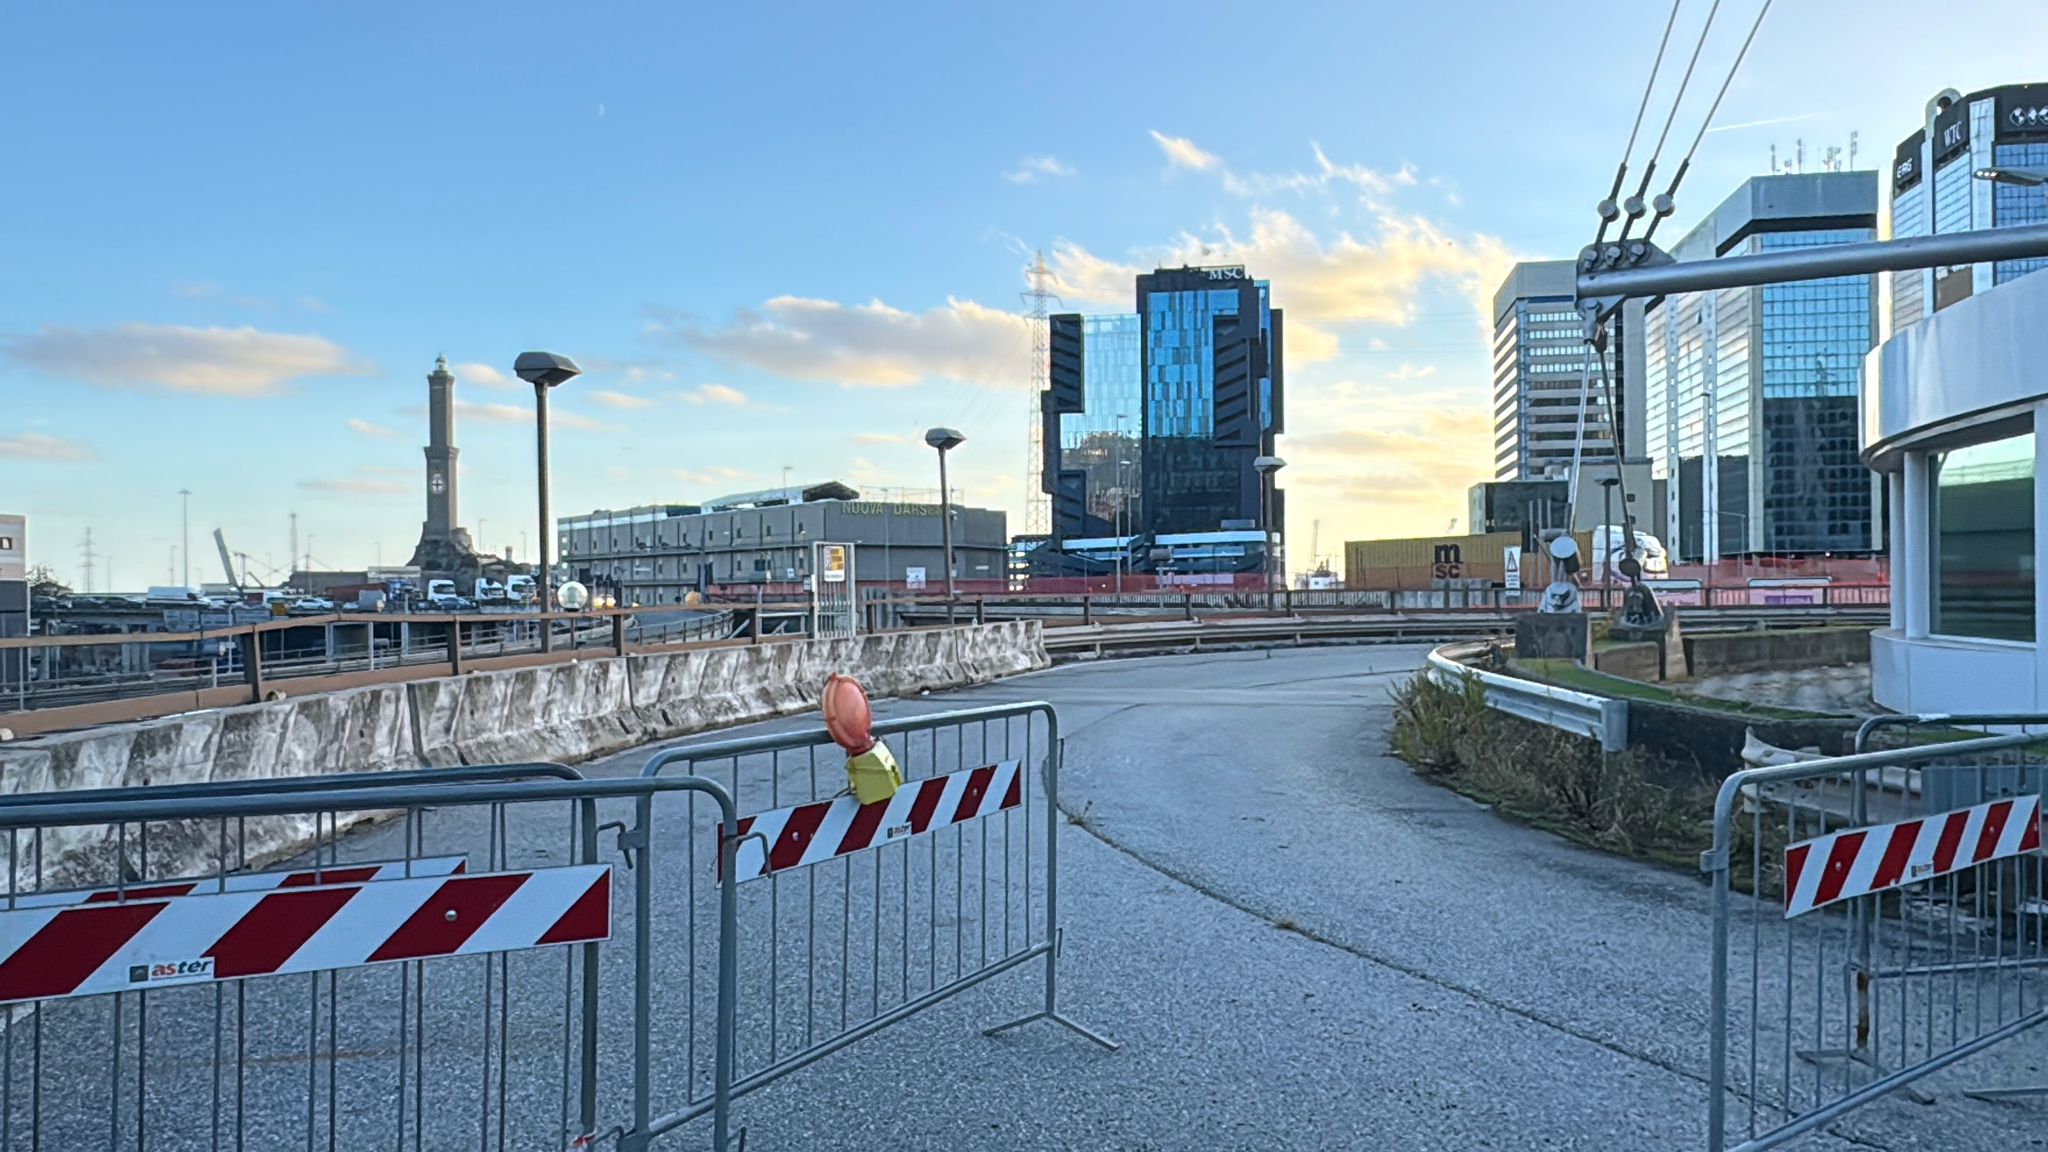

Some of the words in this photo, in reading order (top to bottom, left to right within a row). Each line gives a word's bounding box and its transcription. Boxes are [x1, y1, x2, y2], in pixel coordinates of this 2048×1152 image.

[1944, 121, 1962, 147] WTC
[1209, 267, 1244, 280] MSC
[841, 501, 884, 515] NUOVA
[152, 961, 213, 977] aster
